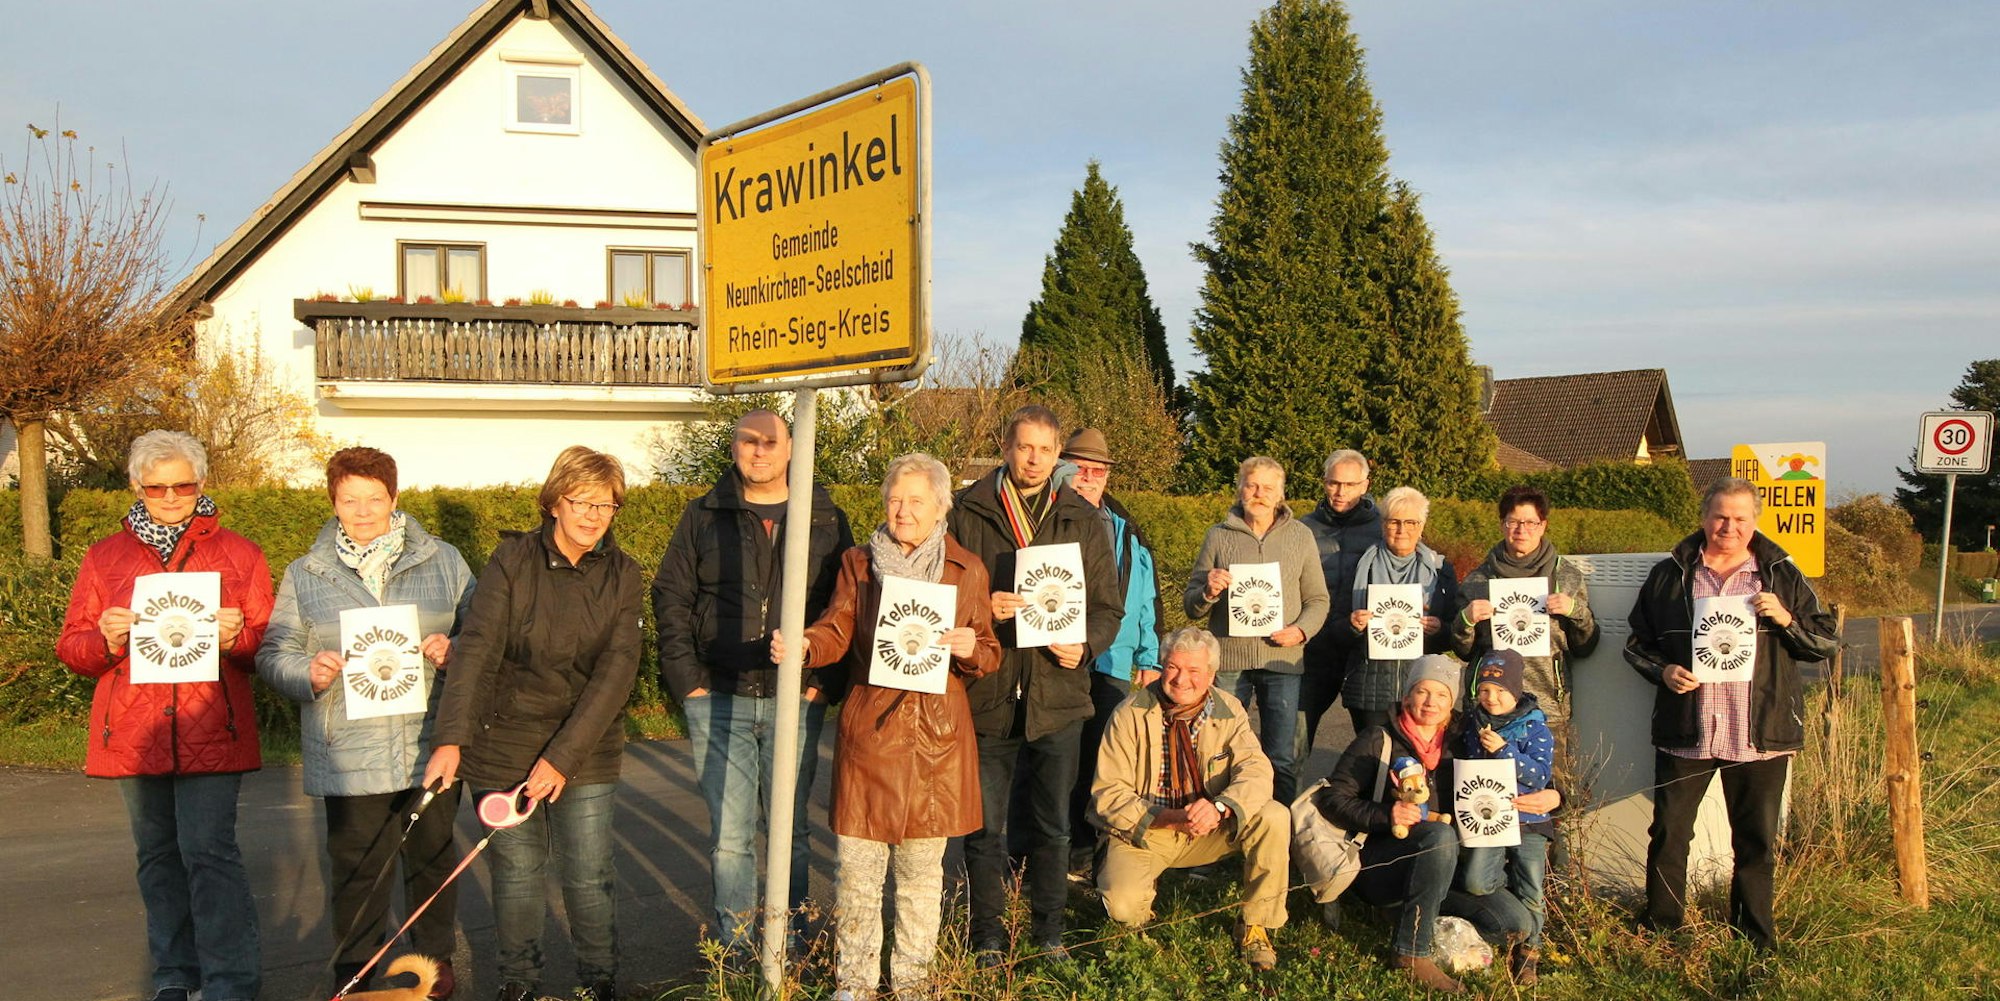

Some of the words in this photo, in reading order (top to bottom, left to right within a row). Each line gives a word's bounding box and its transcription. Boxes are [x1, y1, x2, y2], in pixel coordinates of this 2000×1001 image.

[713, 113, 902, 225] Krawinkel
[772, 220, 838, 260] Gemeinde
[726, 249, 893, 309] Neunkirchen-Seelscheid
[728, 303, 890, 353] Rhein-Sieg-Kreis
[1942, 428, 1966, 445] 30
[1735, 459, 1759, 481] HIER
[1936, 456, 1968, 466] ZONE
[1758, 486, 1815, 507] PIELEN
[1776, 513, 1814, 534] WIR
[1231, 606, 1250, 626] NEIN
[1371, 627, 1390, 648] NEIN
[1494, 623, 1515, 645] NEIN
[135, 636, 168, 666] NEIN
[877, 639, 903, 671] NEIN
[1695, 646, 1719, 669] NEIN
[347, 672, 378, 700] NEIN
[1458, 810, 1481, 834] NEIN
